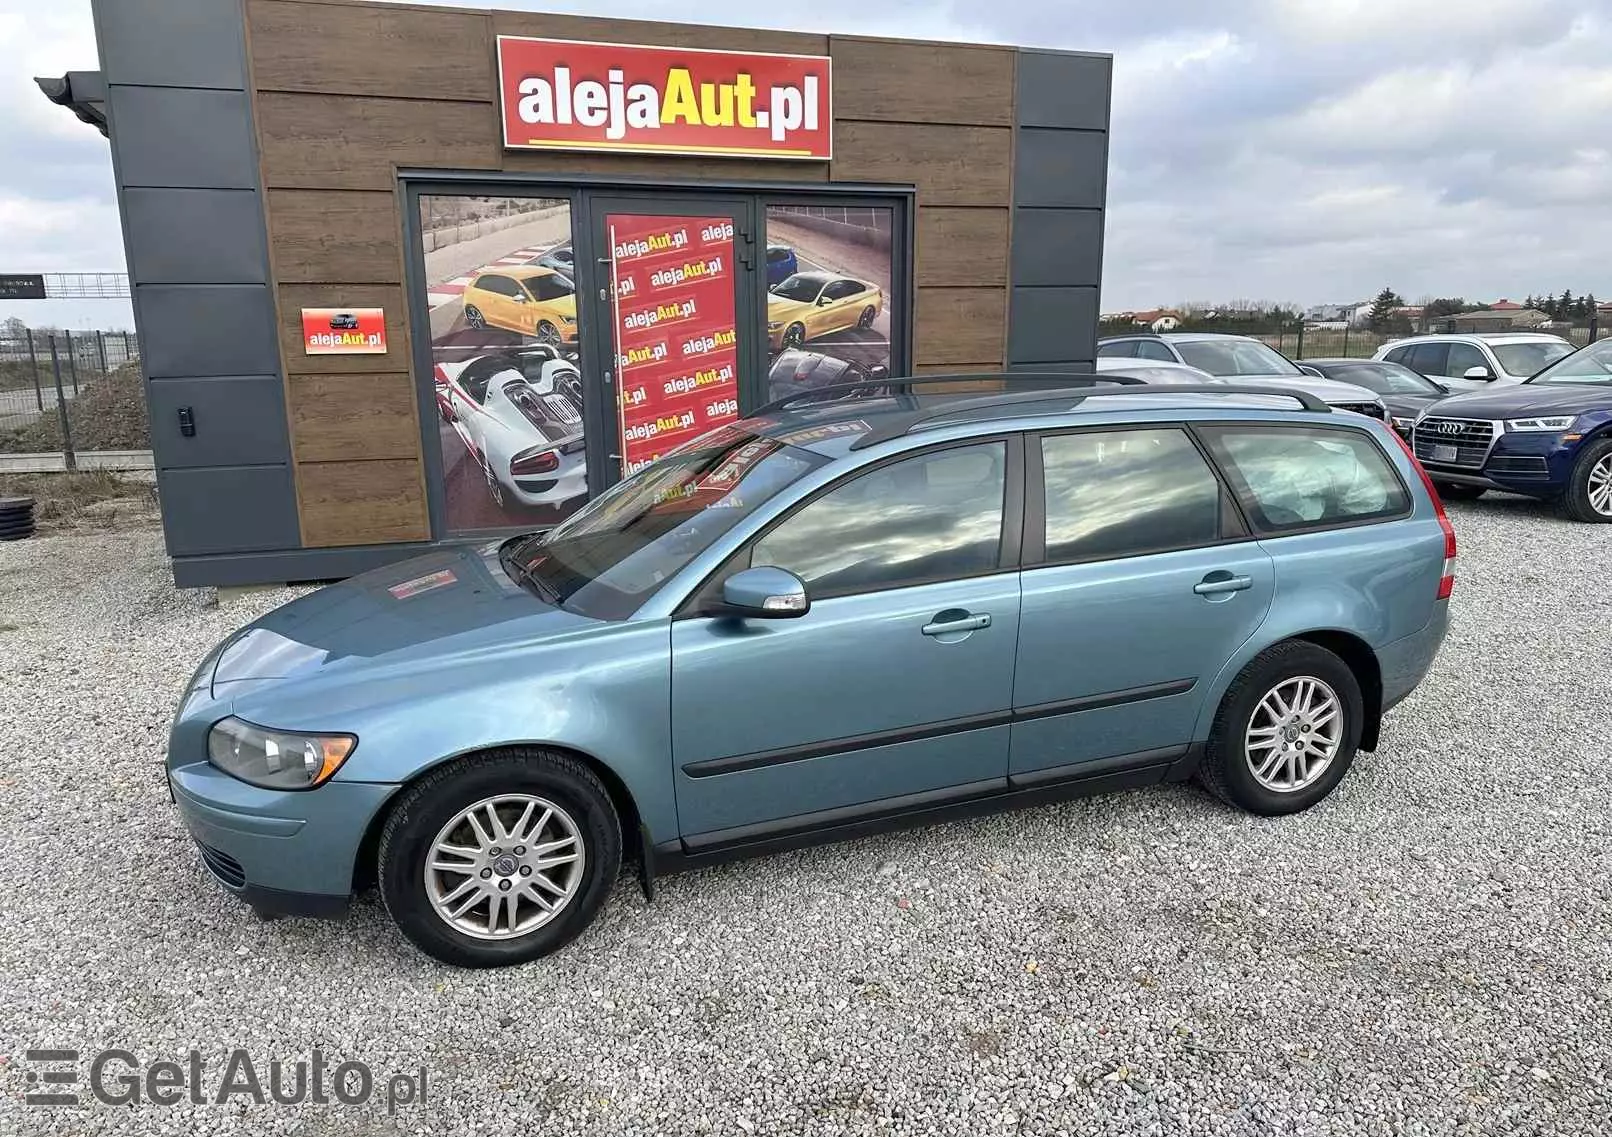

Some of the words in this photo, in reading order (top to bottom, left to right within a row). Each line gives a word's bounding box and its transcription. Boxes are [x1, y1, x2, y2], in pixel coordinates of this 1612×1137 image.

[518, 66, 818, 141] alejaAut.pl
[616, 229, 688, 258] alejaAut.pl
[651, 257, 722, 286] alejaAut.pl
[624, 300, 696, 329] alejaAut.pl
[310, 332, 381, 347] alejaAut.pl
[663, 365, 733, 394] alejaAut.pl
[624, 411, 694, 441] alejaAut.pl
